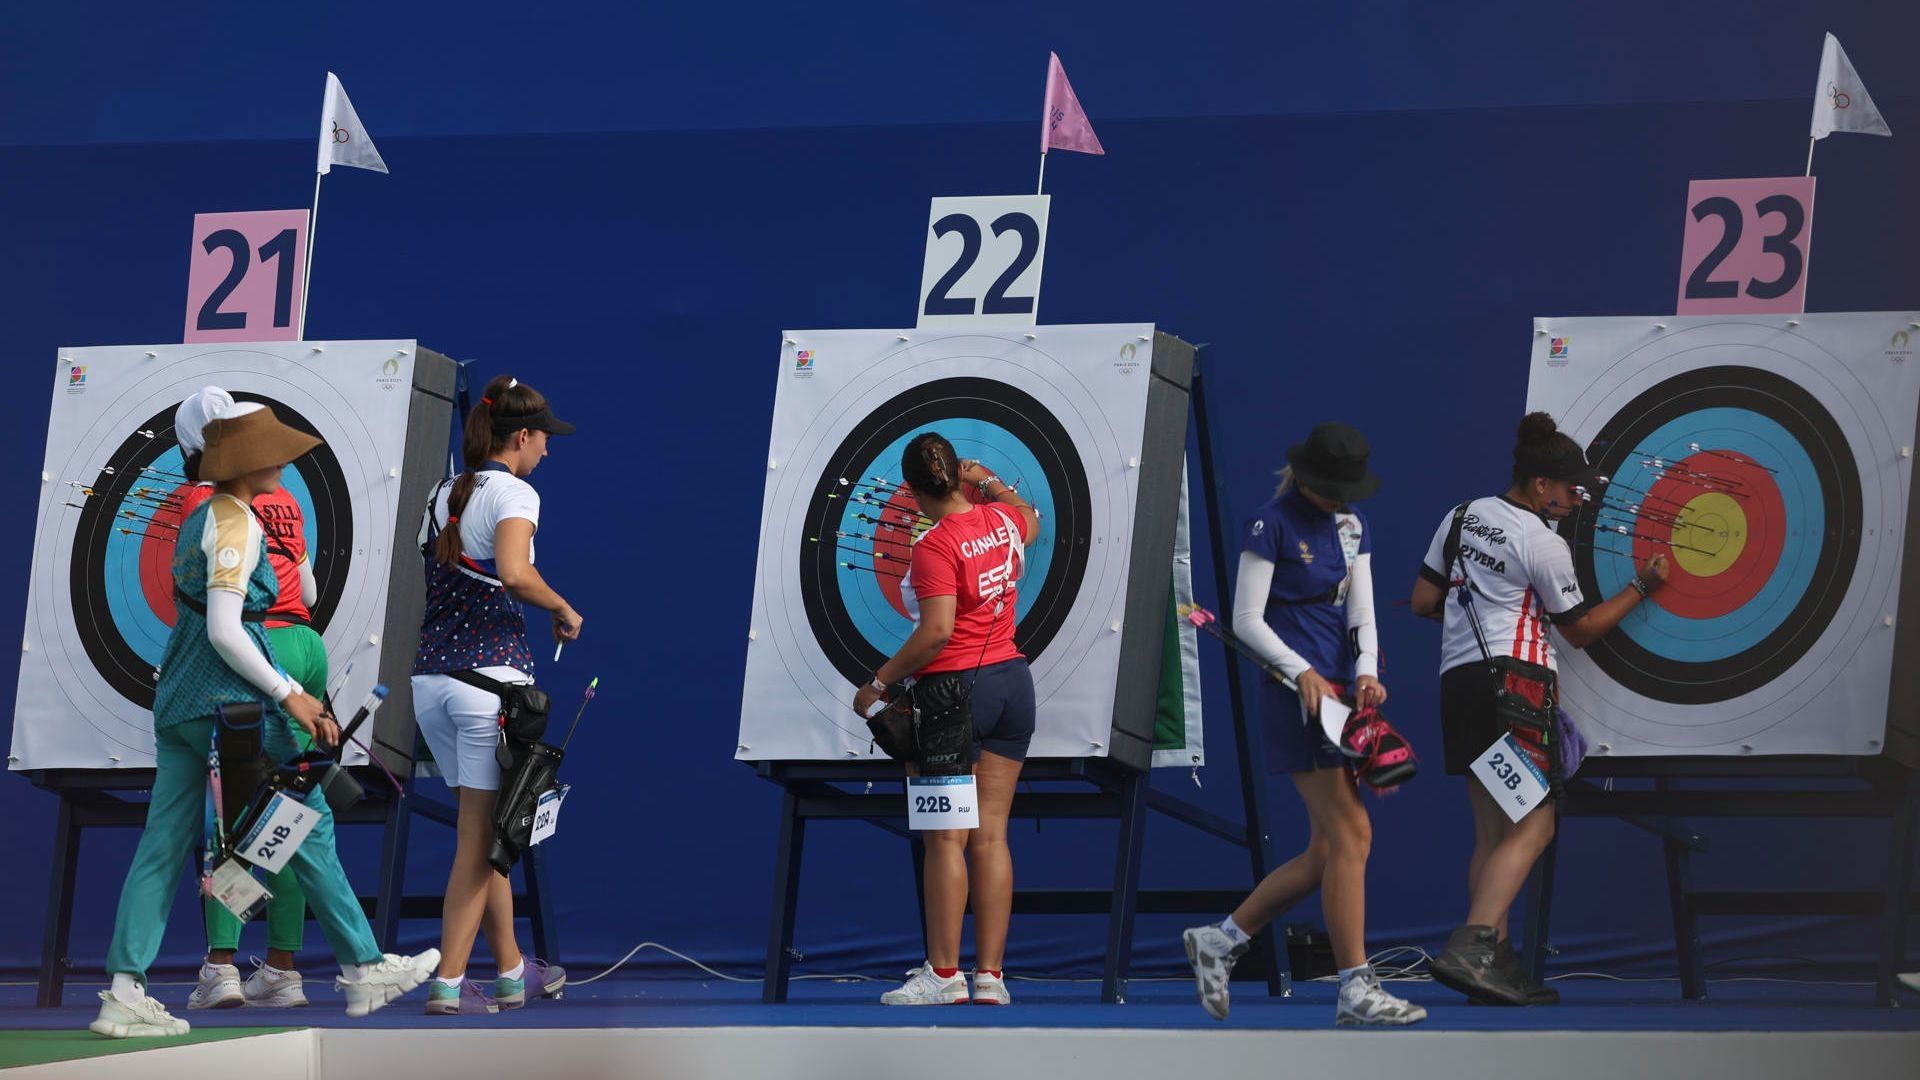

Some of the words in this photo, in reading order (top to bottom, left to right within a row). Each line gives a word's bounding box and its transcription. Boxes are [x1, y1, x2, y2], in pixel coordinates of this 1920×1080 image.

[1684, 194, 1805, 300] 23
[923, 212, 1040, 316] 22
[196, 228, 298, 331] 21
[1462, 514, 1489, 538] Puerto
[1485, 528, 1507, 547] Rico
[961, 526, 1010, 558] CANALE
[1461, 544, 1506, 574] RIVERA
[927, 752, 961, 762] HOYT
[1487, 752, 1523, 791] 23B
[915, 795, 952, 814] 22B
[958, 806, 971, 814] RW
[1514, 794, 1528, 807] RW
[535, 810, 550, 831] 22A
[257, 825, 292, 861] 24B
